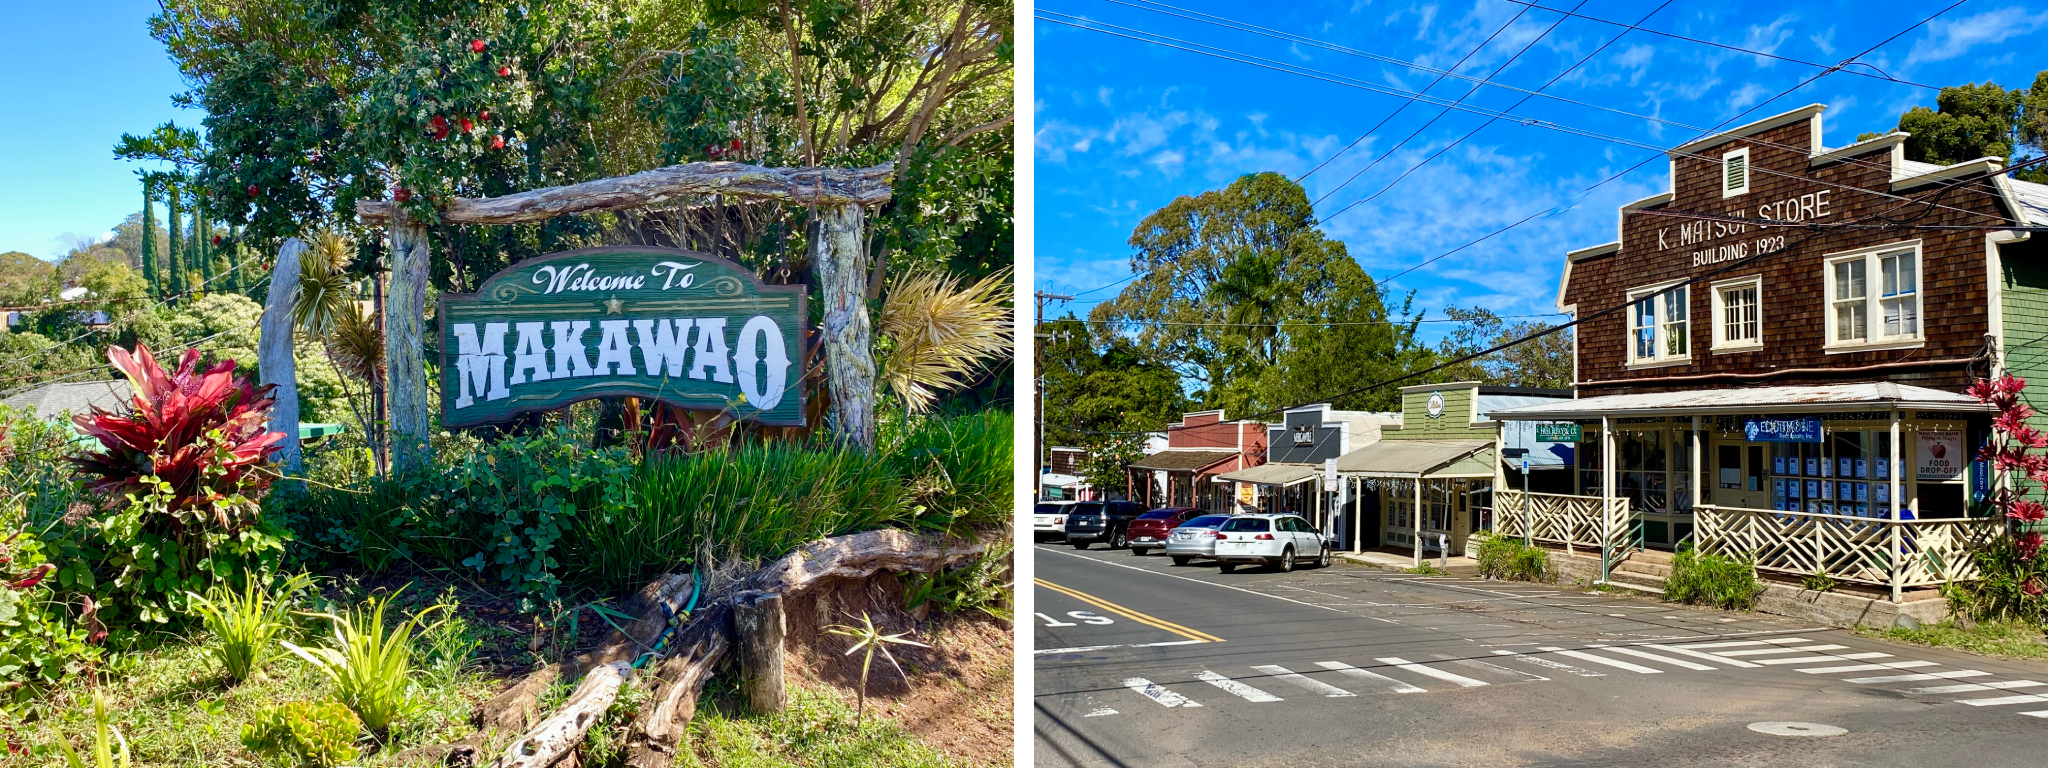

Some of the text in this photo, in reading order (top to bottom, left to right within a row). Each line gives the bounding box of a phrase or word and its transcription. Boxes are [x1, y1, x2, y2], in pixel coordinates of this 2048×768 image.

[1680, 209, 1745, 247] MATSUI
[1759, 189, 1831, 229] STORE
[1693, 235, 1785, 268] BUILDING 1923
[532, 261, 702, 295] Welcome To
[453, 315, 792, 411] MAKAWAO
